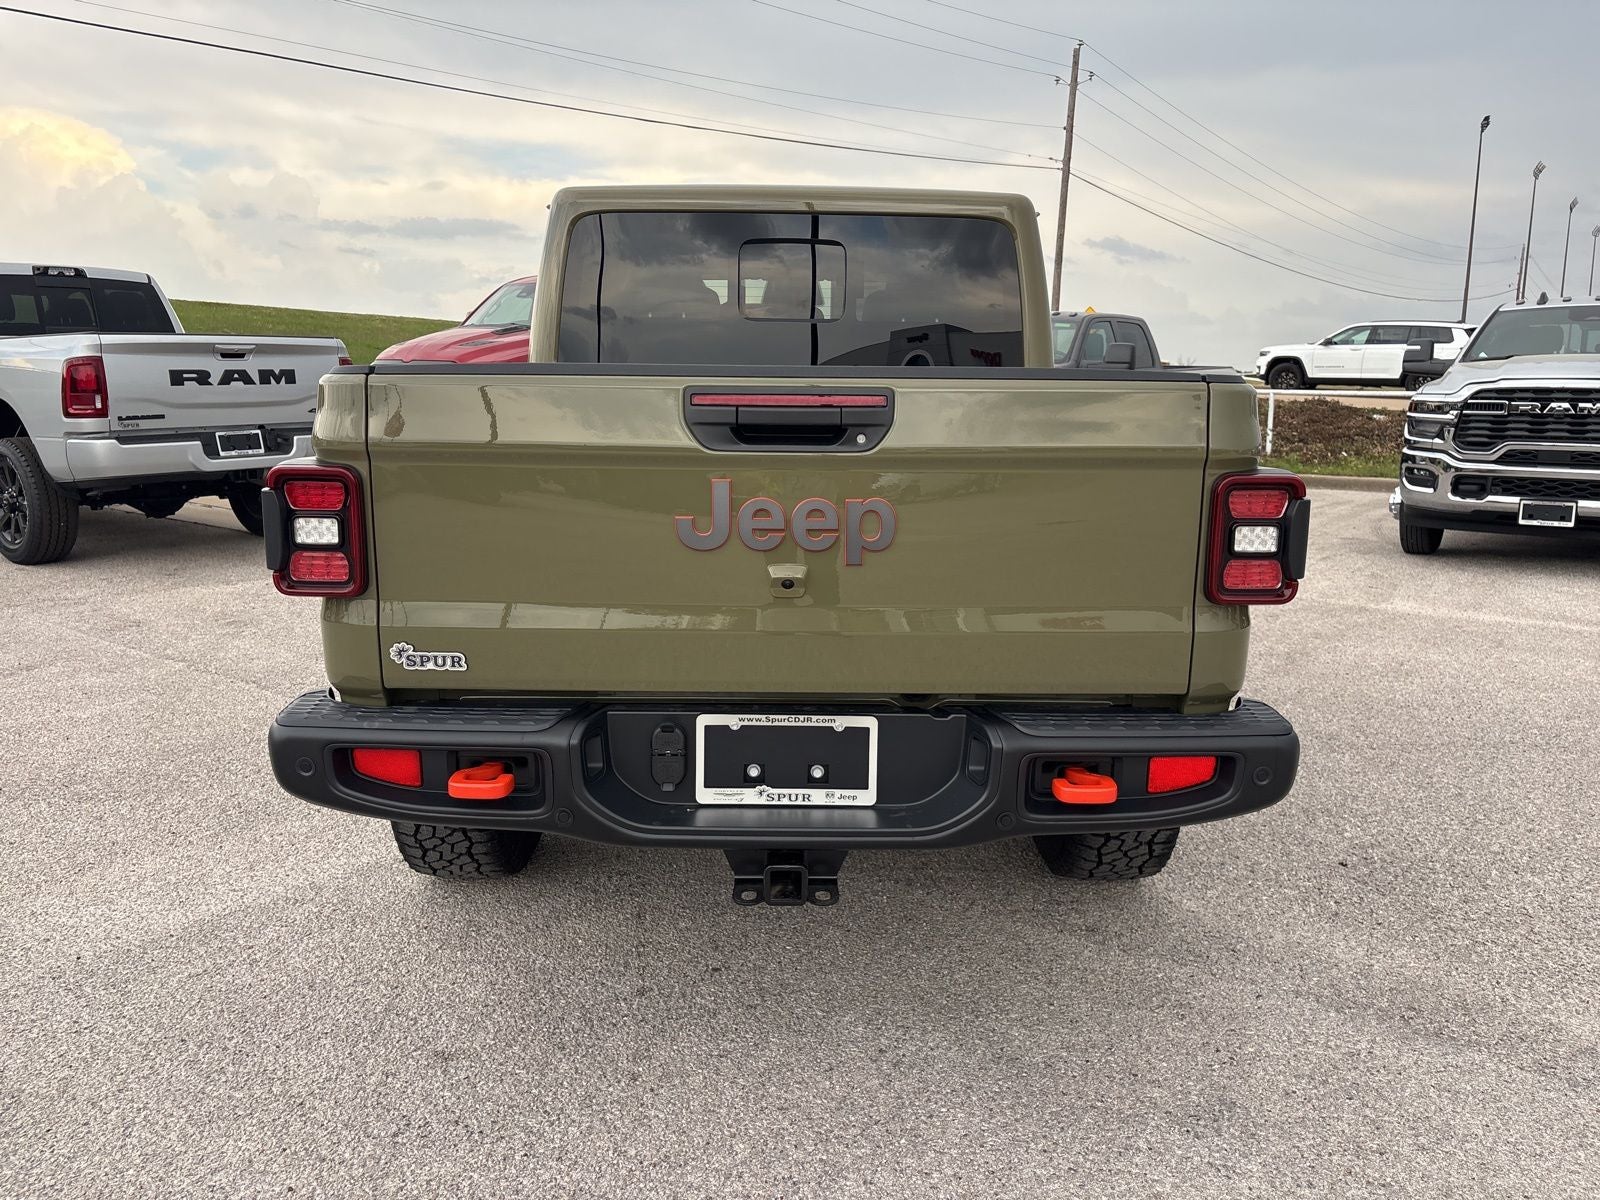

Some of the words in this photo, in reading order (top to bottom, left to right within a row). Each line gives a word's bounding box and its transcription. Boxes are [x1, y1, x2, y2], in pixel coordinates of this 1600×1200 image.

[168, 369, 297, 386] RAM
[1509, 401, 1600, 414] RAM
[675, 478, 897, 566] Jeep
[405, 655, 463, 668] SPUR
[738, 716, 836, 724] www.SpurCDJR.com
[766, 793, 812, 802] SPUR
